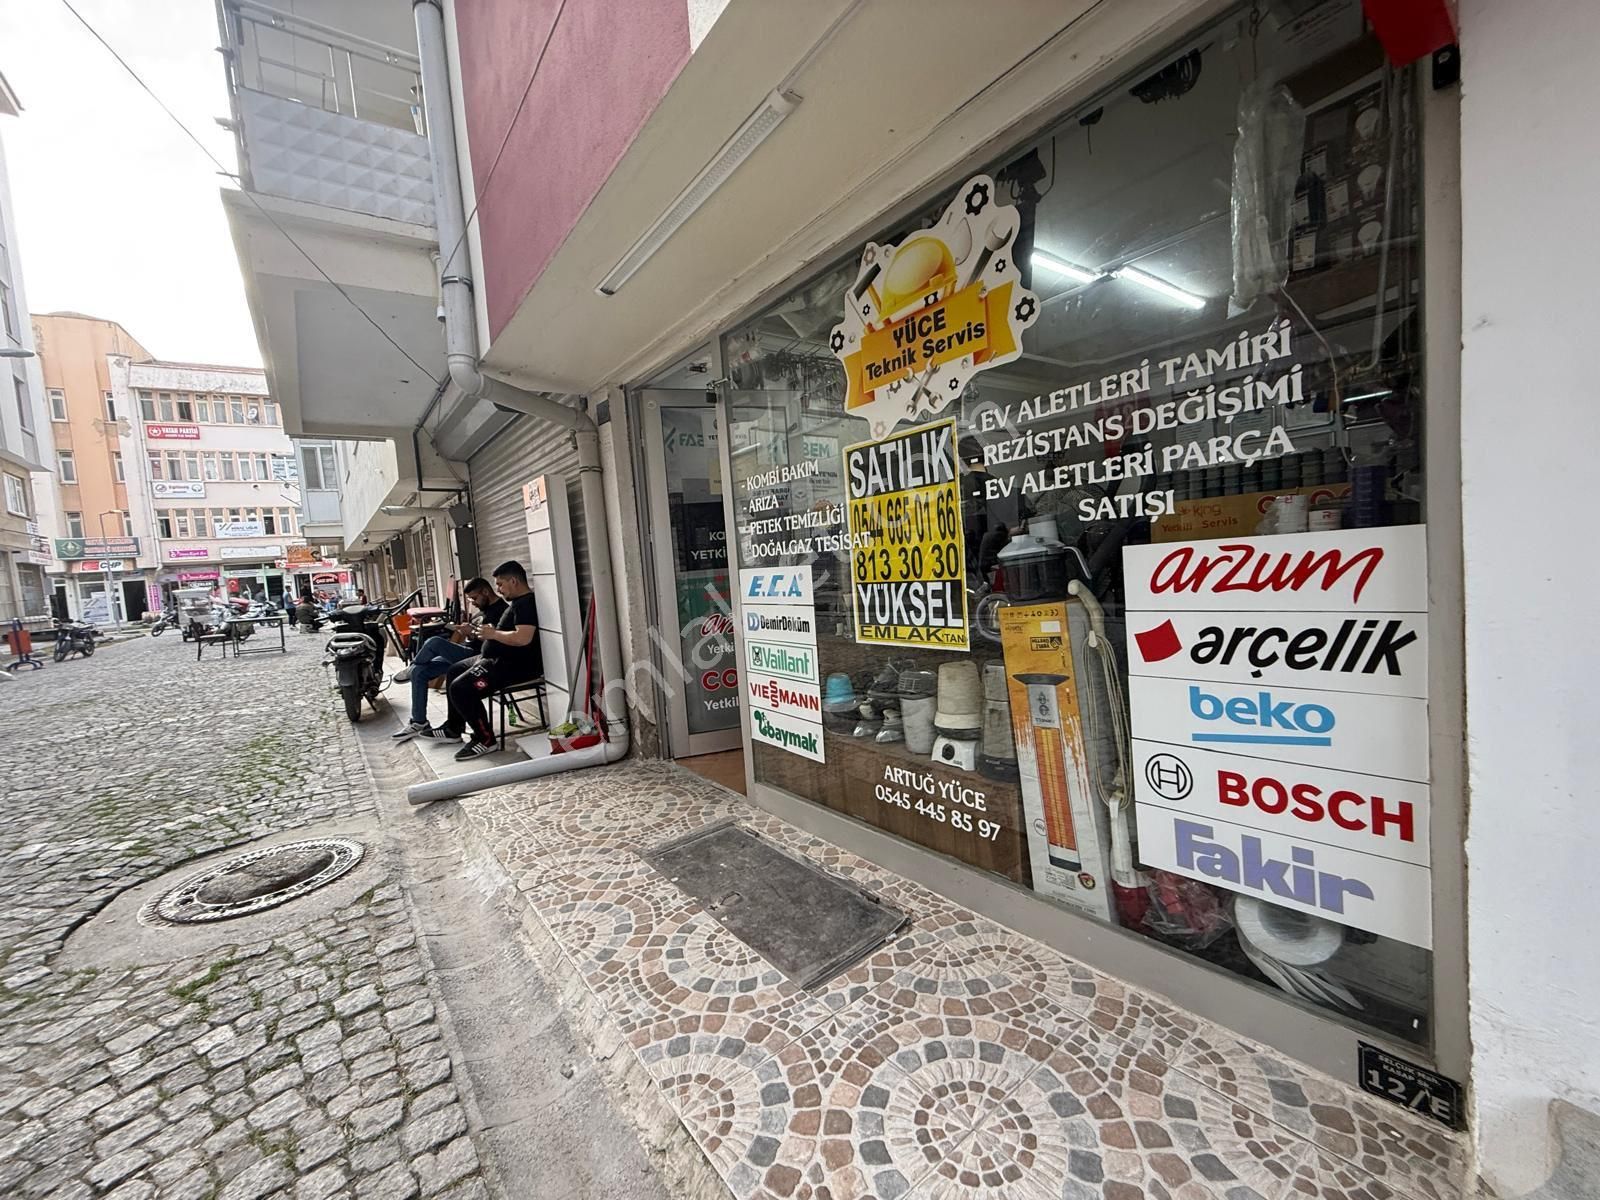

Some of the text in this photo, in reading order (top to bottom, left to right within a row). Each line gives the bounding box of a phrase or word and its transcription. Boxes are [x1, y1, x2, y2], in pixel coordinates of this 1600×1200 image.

[866, 322, 986, 381] Teknik Servis
[892, 308, 946, 349] YÜCE
[981, 319, 1292, 432] EV ALETLERİ TAMİRİ
[983, 428, 1124, 467] REZİSTANS
[1132, 364, 1304, 425] DEĞİŞİMİ
[746, 465, 780, 491] KOMBİ
[782, 460, 819, 482] BAKIM
[849, 427, 954, 498] SATILIK
[985, 475, 1016, 501] EV
[1021, 443, 1154, 495] ALETLERİ
[1162, 426, 1297, 473] PARÇA
[748, 494, 779, 513] ARIZA
[750, 503, 845, 536] PETEK TEMİZLİĞİ
[887, 496, 912, 545] 665
[915, 492, 932, 543] 01
[937, 488, 956, 541] 66
[1078, 490, 1175, 523] SATIŞI
[1202, 516, 1239, 530] Servis
[751, 530, 871, 558] DOĞALGAZ TESİSAT
[856, 543, 960, 581] 813 30 30
[1150, 544, 1384, 604] arzum
[857, 581, 964, 628] YÜKSEL
[762, 648, 810, 675] Vaillant
[1190, 619, 1418, 679] arçelik
[750, 681, 819, 711] VIESSMANN
[1189, 686, 1335, 734] beko
[766, 719, 818, 754] baymak
[884, 765, 986, 812] ARTUĞ YÜCE
[1216, 770, 1415, 843] BOSCH
[875, 784, 1000, 841] 0545 445 85 97
[1173, 818, 1374, 915] Fakir
[1368, 1069, 1450, 1121] 12/E
